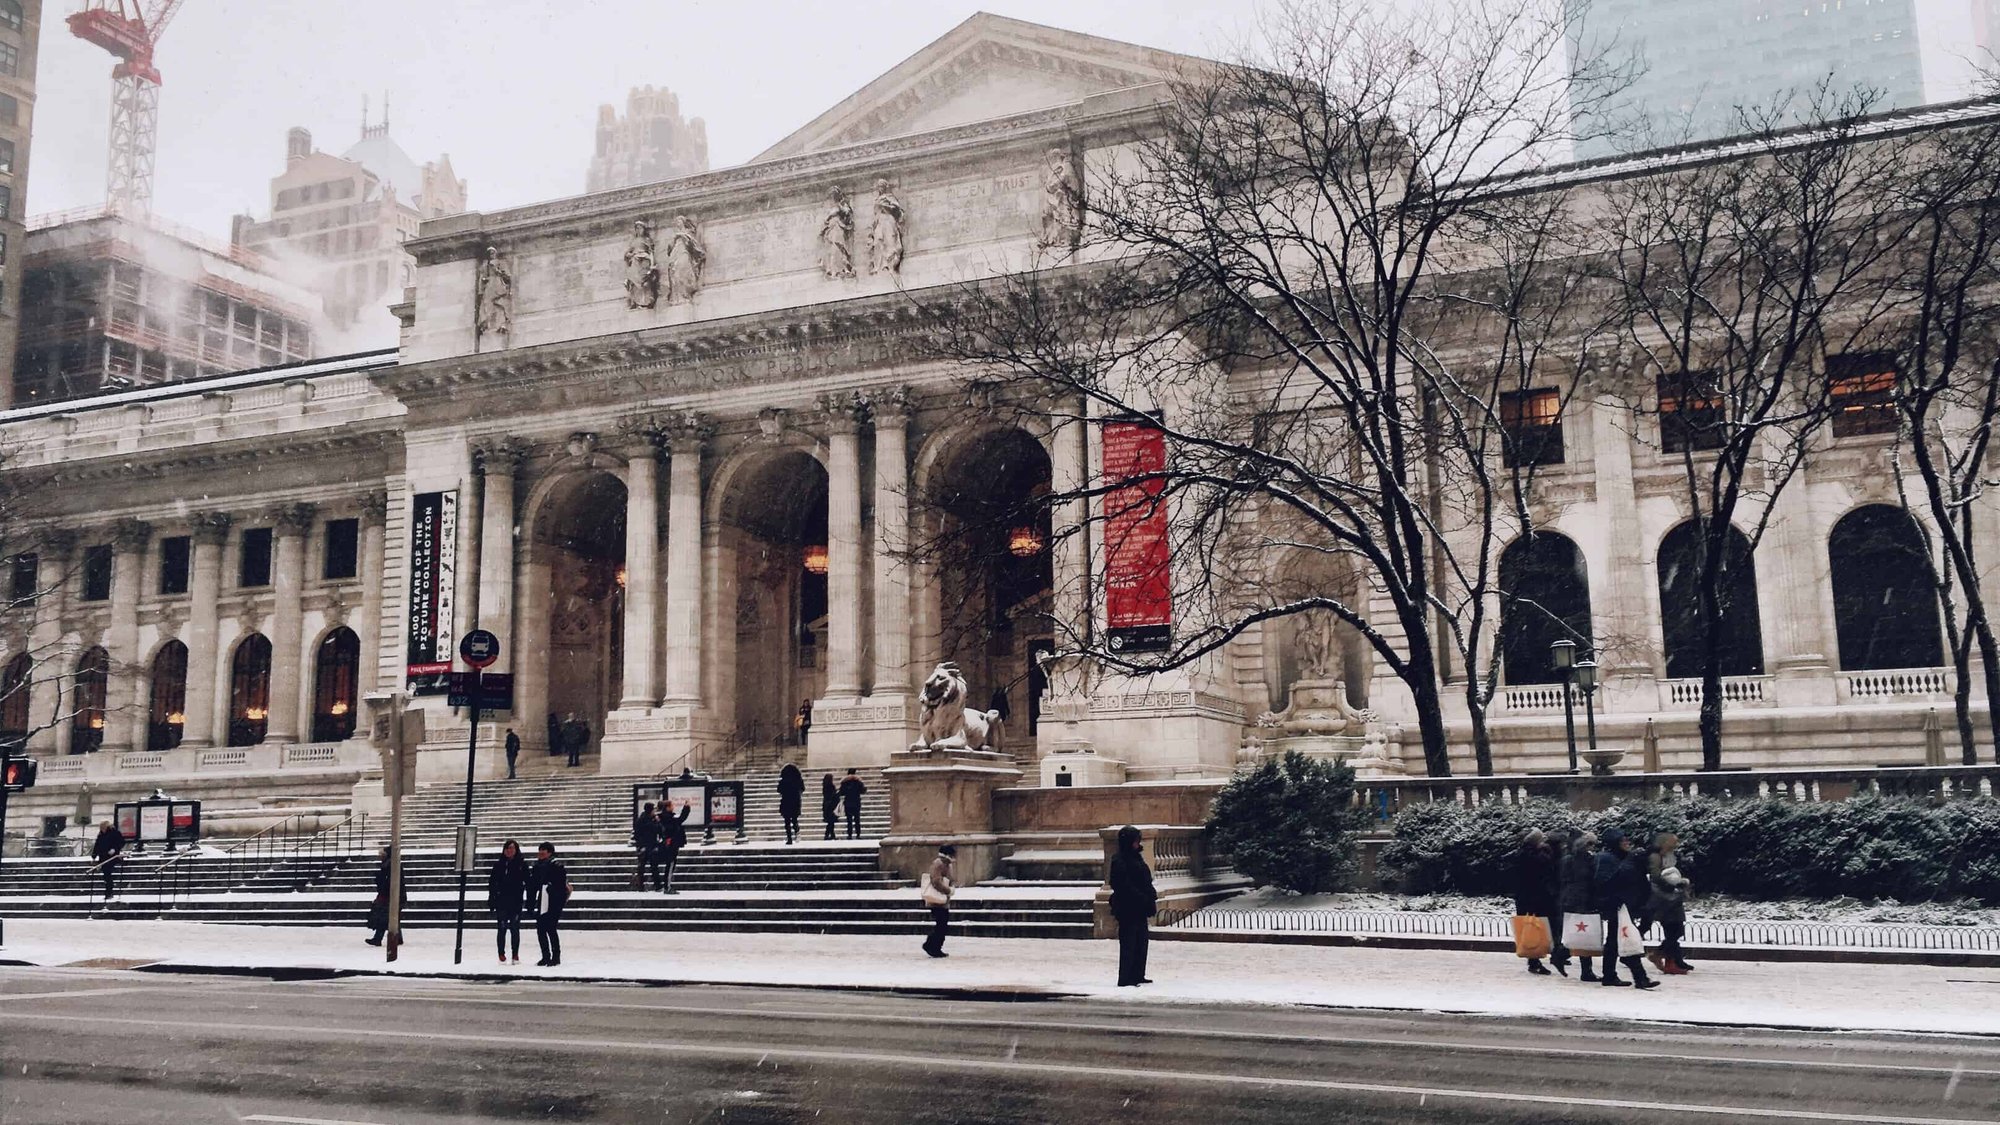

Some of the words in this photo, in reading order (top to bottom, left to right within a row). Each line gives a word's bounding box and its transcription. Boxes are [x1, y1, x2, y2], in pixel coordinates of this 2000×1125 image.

[994, 175, 1033, 193] TRUST
[695, 365, 752, 385] YORK
[767, 352, 838, 376] PUBLIC
[858, 338, 944, 363] LIBRA
[415, 550, 422, 566] OF
[423, 506, 432, 589] COLLECTION
[413, 570, 421, 612] YEARS
[412, 615, 420, 637] 100
[420, 593, 429, 651] PICTURE
